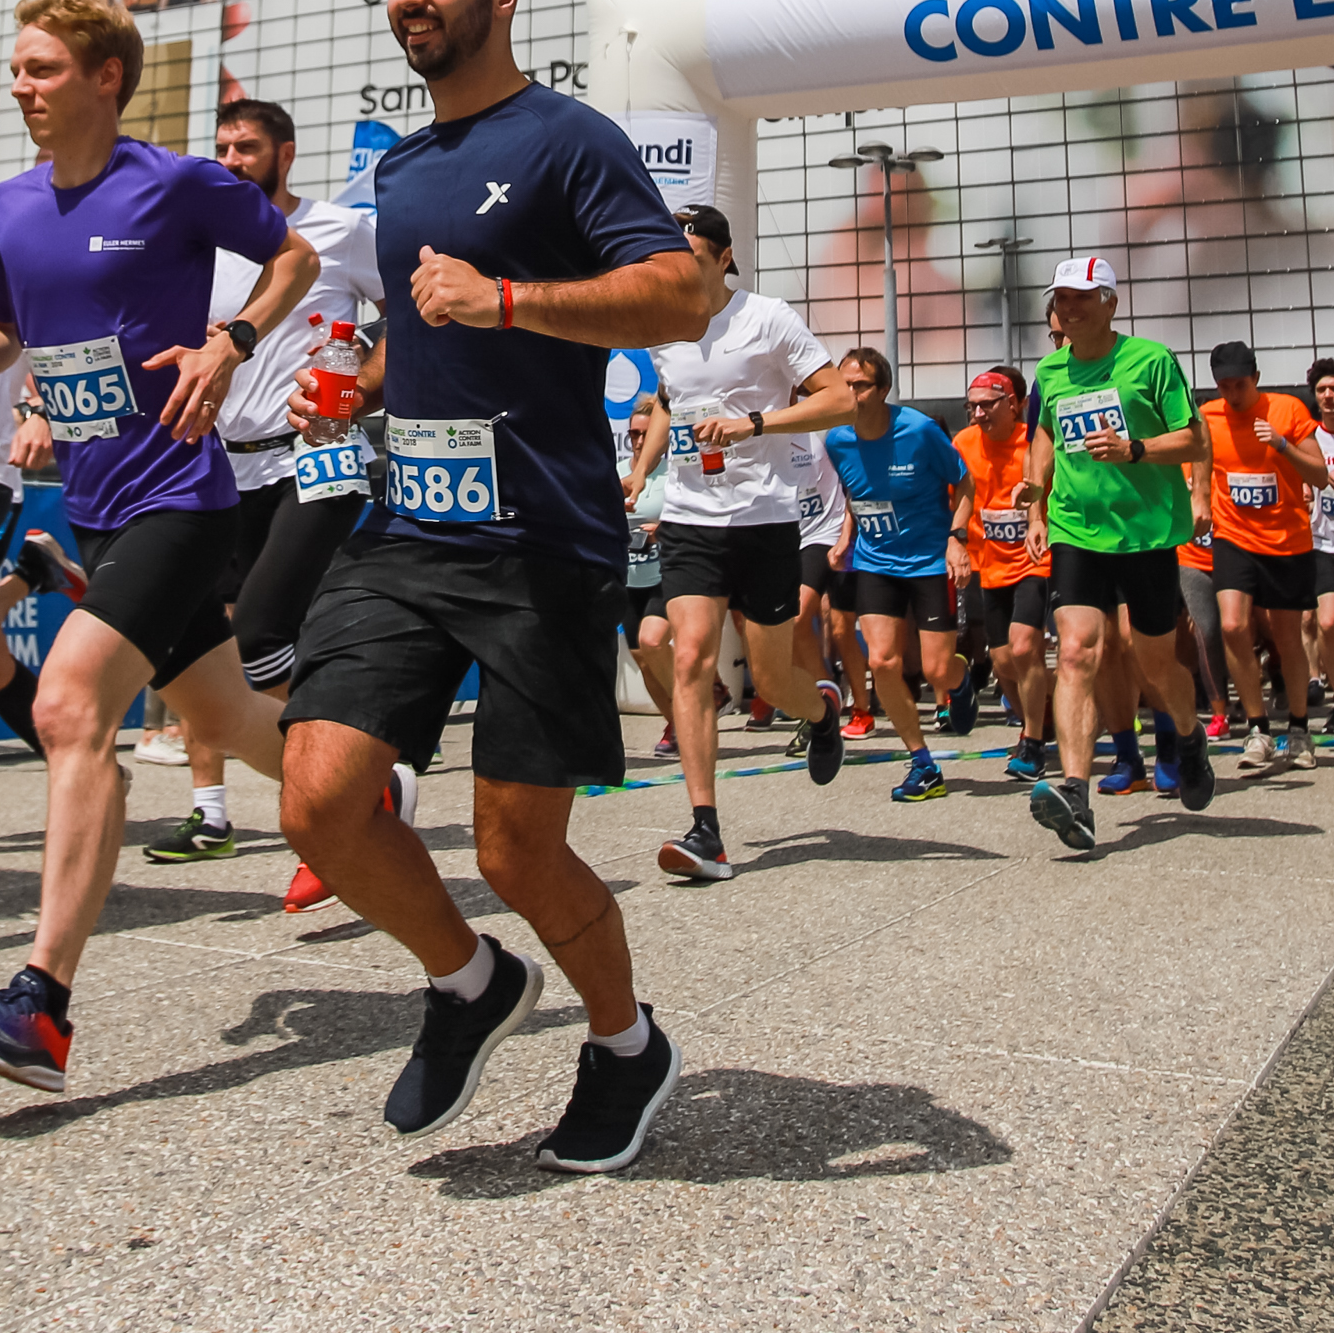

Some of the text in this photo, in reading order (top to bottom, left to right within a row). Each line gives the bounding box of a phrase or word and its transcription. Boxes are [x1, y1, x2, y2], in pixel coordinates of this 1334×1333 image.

[40, 373, 127, 418] 3065
[1061, 408, 1122, 440] 2118
[402, 437, 417, 446] 2018
[407, 429, 436, 438] CONTRE
[389, 460, 490, 513] 3586
[1230, 487, 1273, 504] 4051
[860, 515, 893, 533] 911
[984, 522, 1028, 540] 3605
